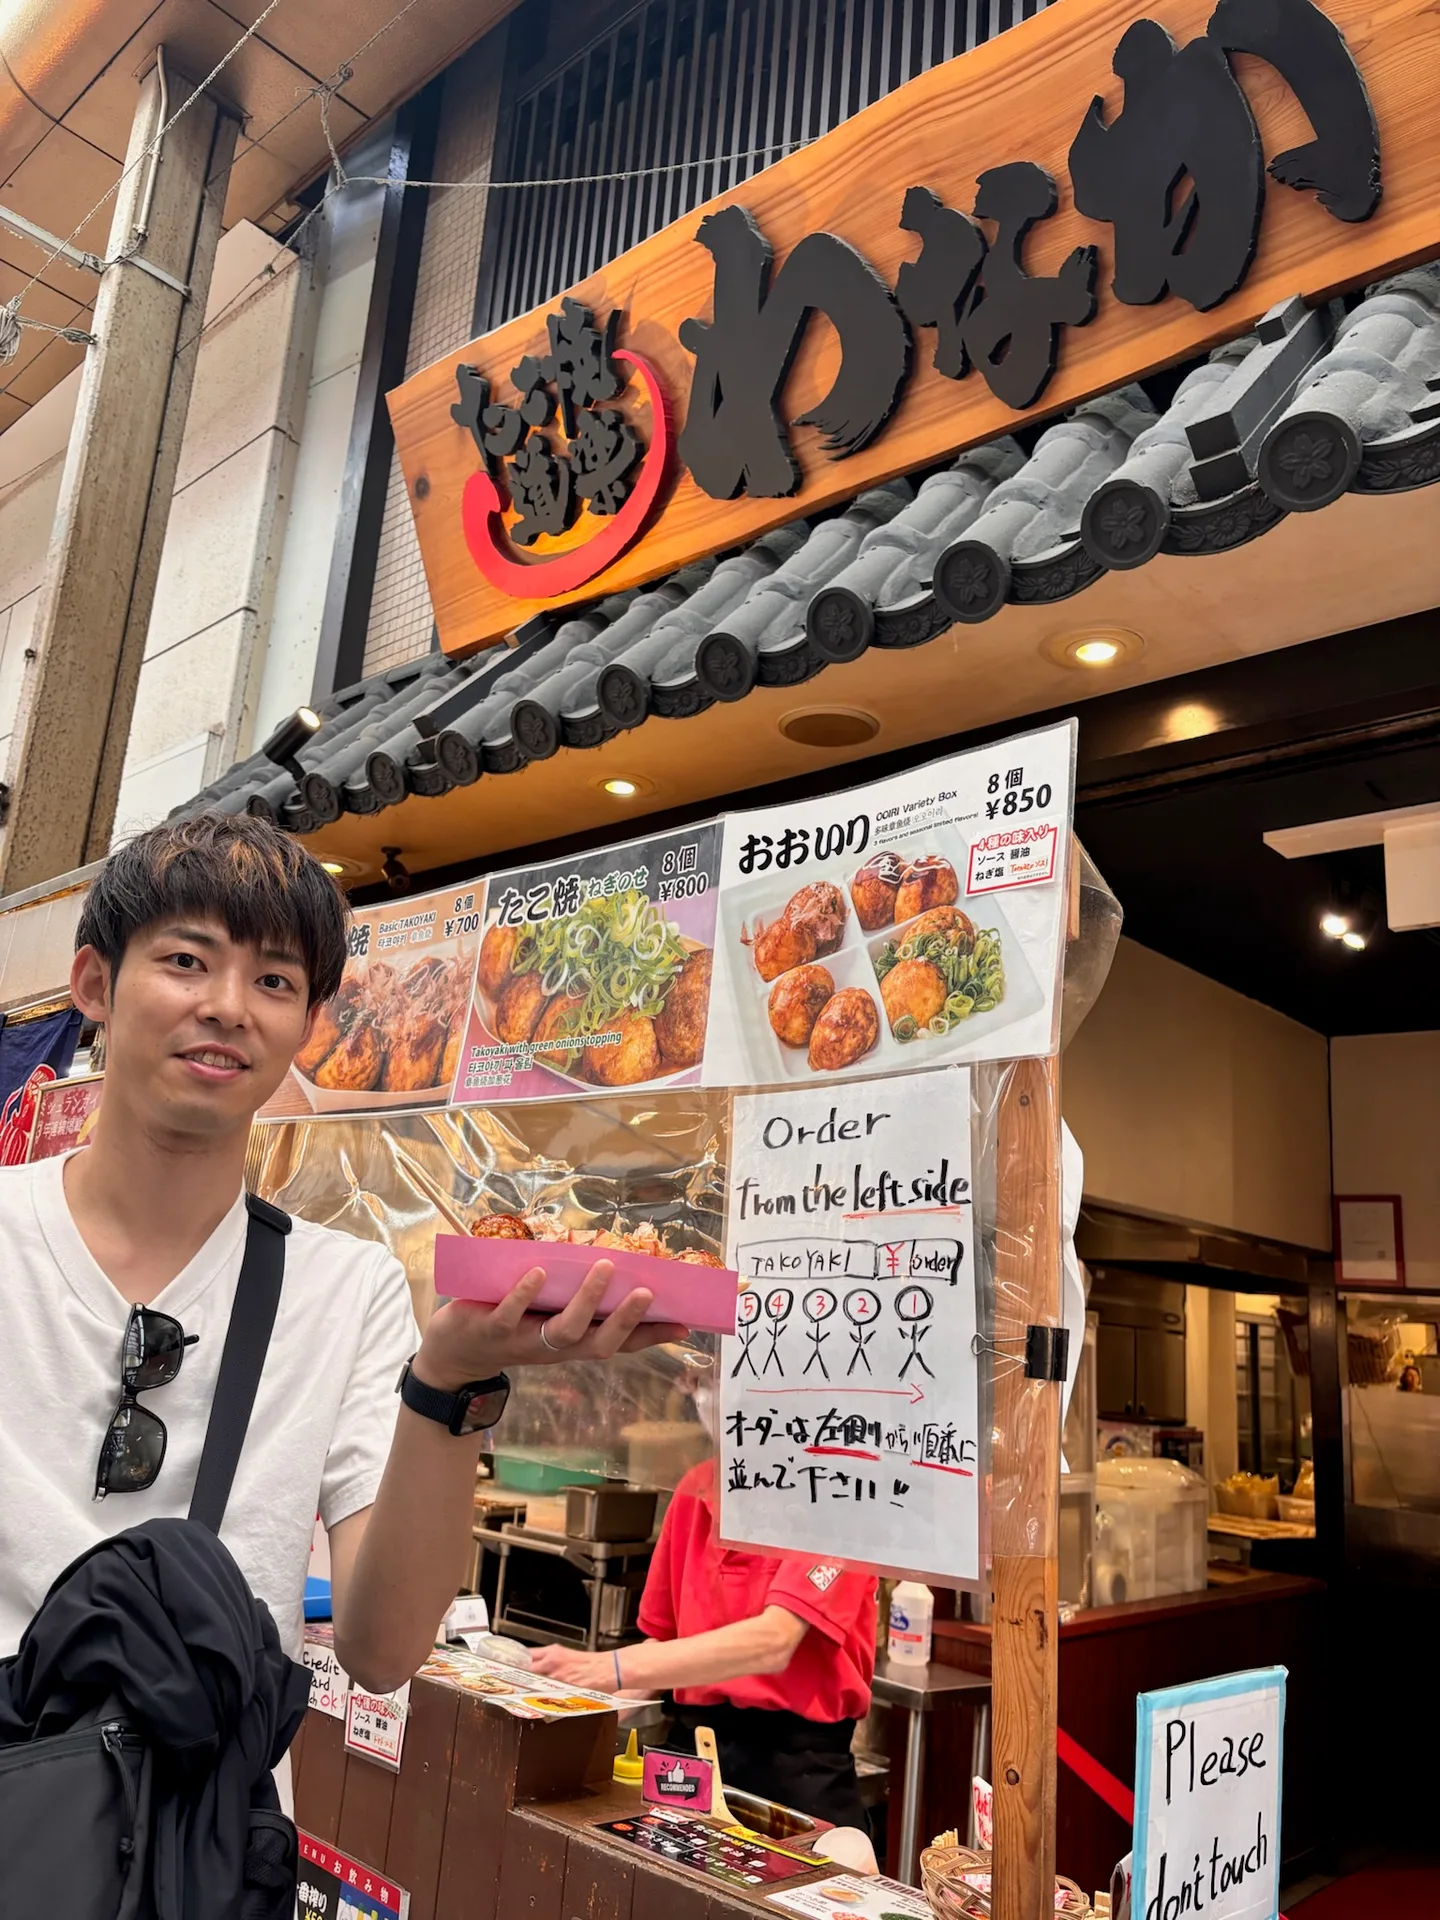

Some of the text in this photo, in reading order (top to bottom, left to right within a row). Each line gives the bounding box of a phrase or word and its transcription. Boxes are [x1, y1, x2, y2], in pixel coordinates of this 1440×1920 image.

[678, 0, 1384, 500] わなか
[987, 767, 1023, 794] 8個
[903, 797, 935, 813] Variety
[938, 790, 958, 802] Box
[985, 784, 1052, 820] ¥850
[739, 814, 870, 874] おおいり
[899, 831, 909, 839] and
[909, 823, 933, 835] seasonal
[663, 846, 698, 874] 8個
[977, 852, 1005, 866] ソース
[588, 866, 649, 897] ねぎのせ
[975, 867, 1004, 881] ねぎ塩
[498, 876, 580, 926] たこ焼
[660, 875, 708, 902] ¥800
[379, 911, 437, 934] Basic TAKOYAKI
[444, 913, 479, 937] ¥700
[471, 1032, 622, 1058] Takoyaki with green onions topping
[762, 1108, 891, 1149] Order
[736, 1158, 972, 1219] from the left side
[751, 1249, 851, 1278] TAKOYAKI
[912, 1250, 957, 1273] order
[744, 1297, 754, 1316] 5
[772, 1295, 784, 1318] 4
[815, 1296, 827, 1316] 3
[858, 1297, 869, 1314] 2
[302, 1651, 340, 1675] Credit
[310, 1675, 331, 1691] ard
[354, 1711, 371, 1724] ソース
[1166, 1719, 1266, 1806] Please
[660, 1782, 696, 1793] RECOMMENDED
[303, 1844, 389, 1904] ENU お飲み物
[1145, 1811, 1268, 1920] don't touch
